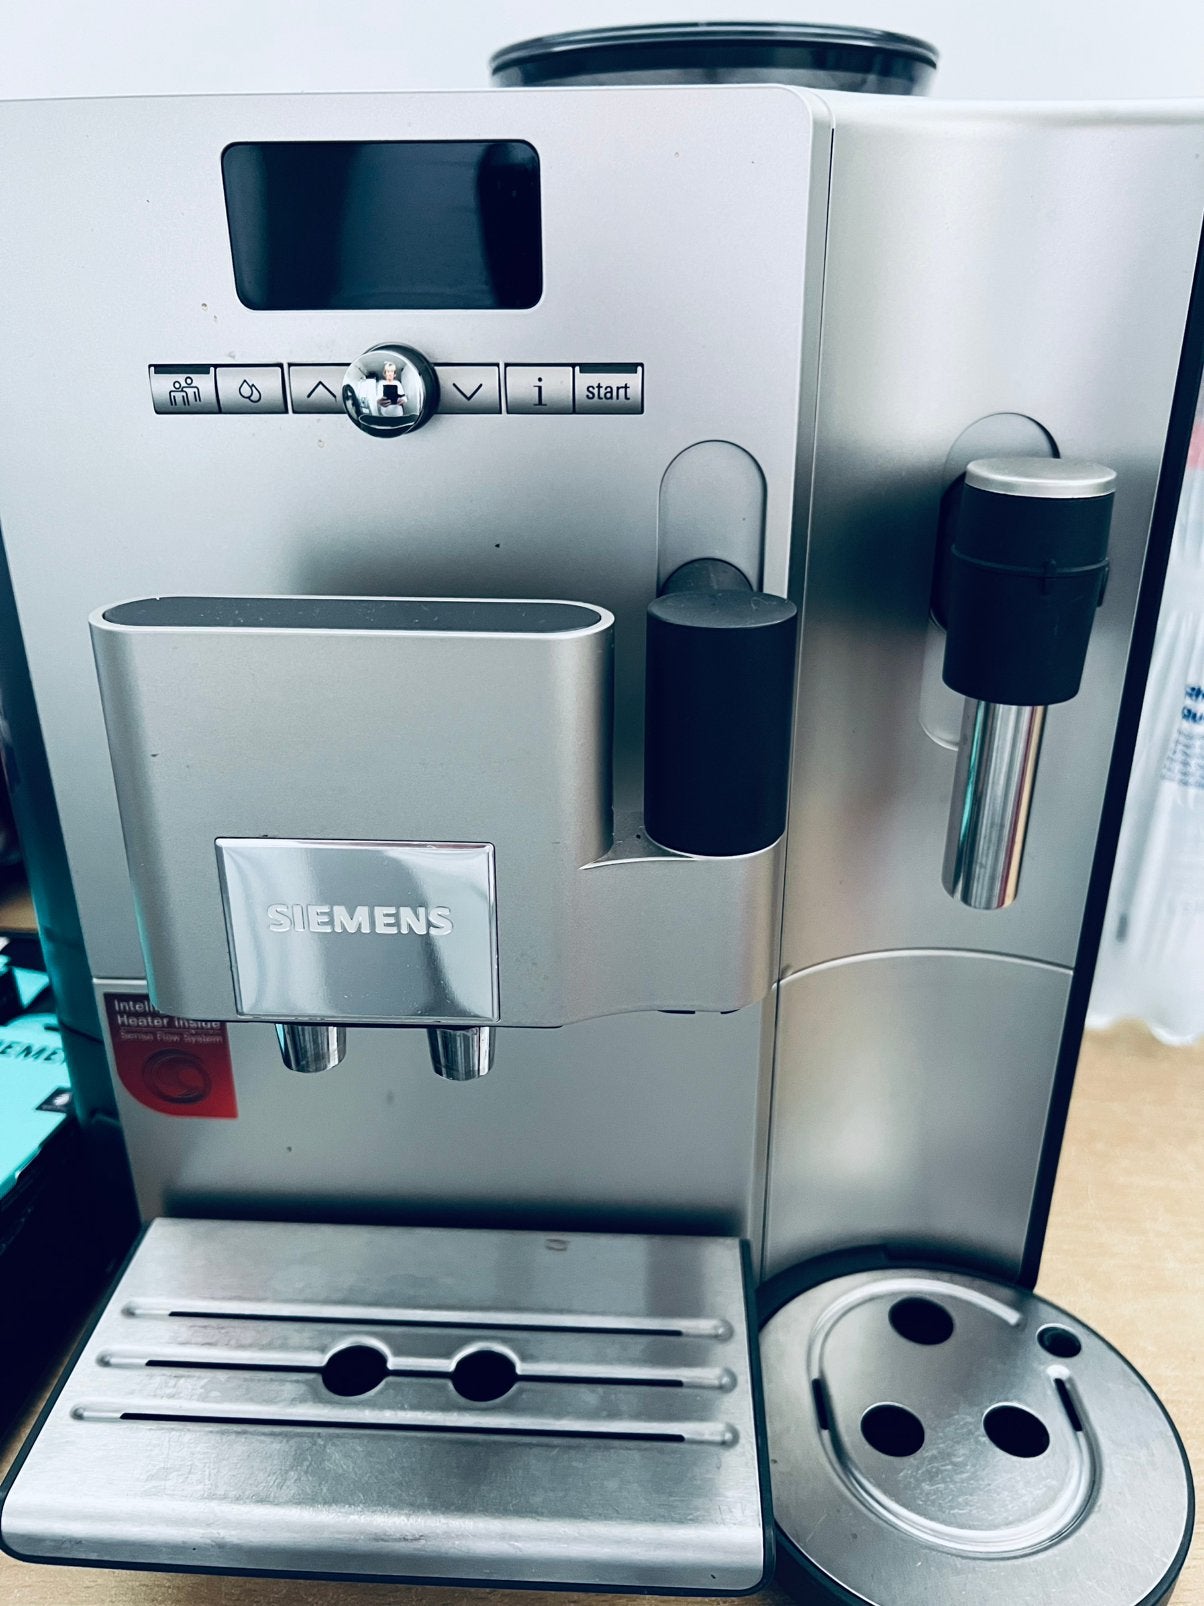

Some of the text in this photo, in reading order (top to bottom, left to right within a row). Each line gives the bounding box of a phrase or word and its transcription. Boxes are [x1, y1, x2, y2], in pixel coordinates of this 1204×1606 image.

[585, 382, 631, 401] start
[267, 903, 454, 936] SIEMENS
[114, 999, 155, 1013] Intell
[117, 1014, 169, 1028] Heater
[183, 1033, 223, 1044] System
[0, 1039, 65, 1065] EME
